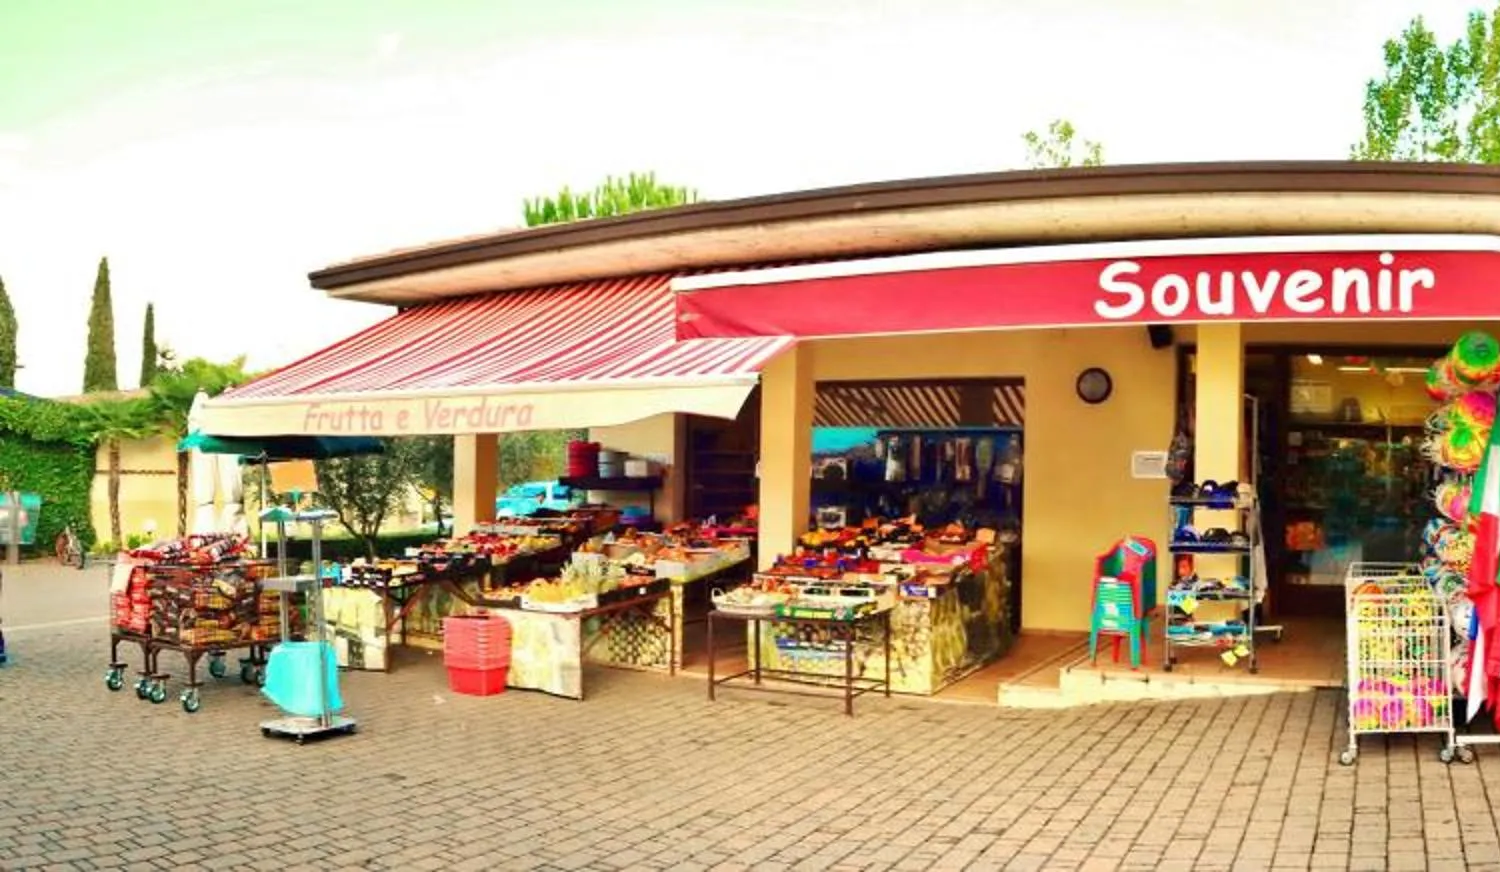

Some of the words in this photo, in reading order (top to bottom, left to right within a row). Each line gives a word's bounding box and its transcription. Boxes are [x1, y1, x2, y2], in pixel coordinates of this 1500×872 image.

[1093, 251, 1435, 319] Souvenir
[302, 402, 383, 432] Frutta
[395, 408, 410, 430] e
[423, 397, 535, 430] Verdura
